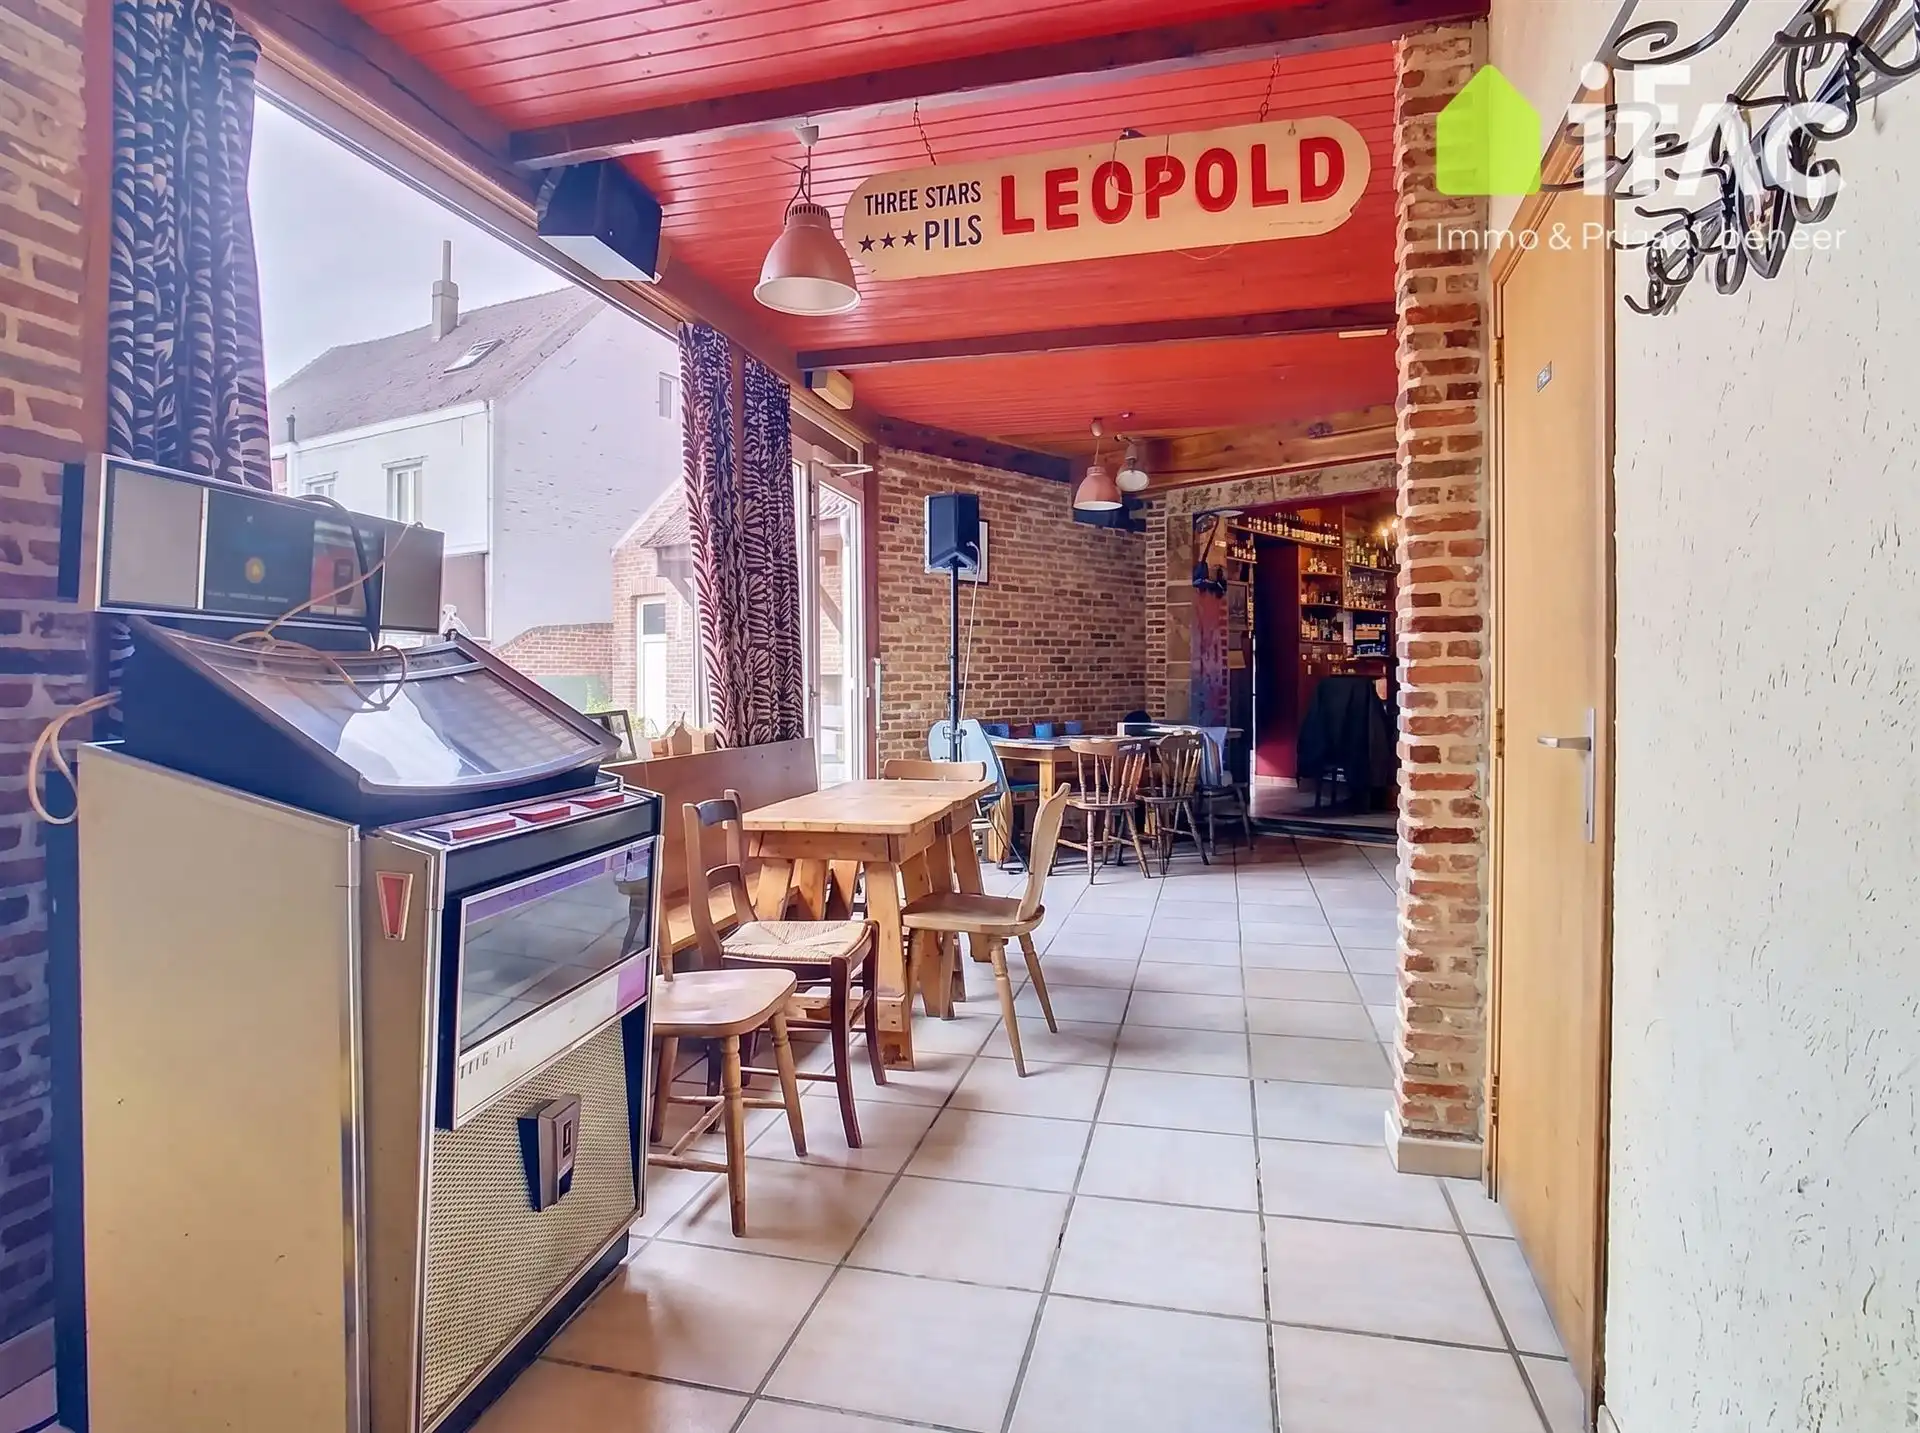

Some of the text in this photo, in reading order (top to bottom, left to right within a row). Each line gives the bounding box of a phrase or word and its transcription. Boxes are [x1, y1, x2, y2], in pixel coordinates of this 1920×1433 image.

[864, 180, 982, 217] THREE STARS
[1000, 135, 1346, 235] LEOPOLD
[924, 215, 983, 251] PILS
